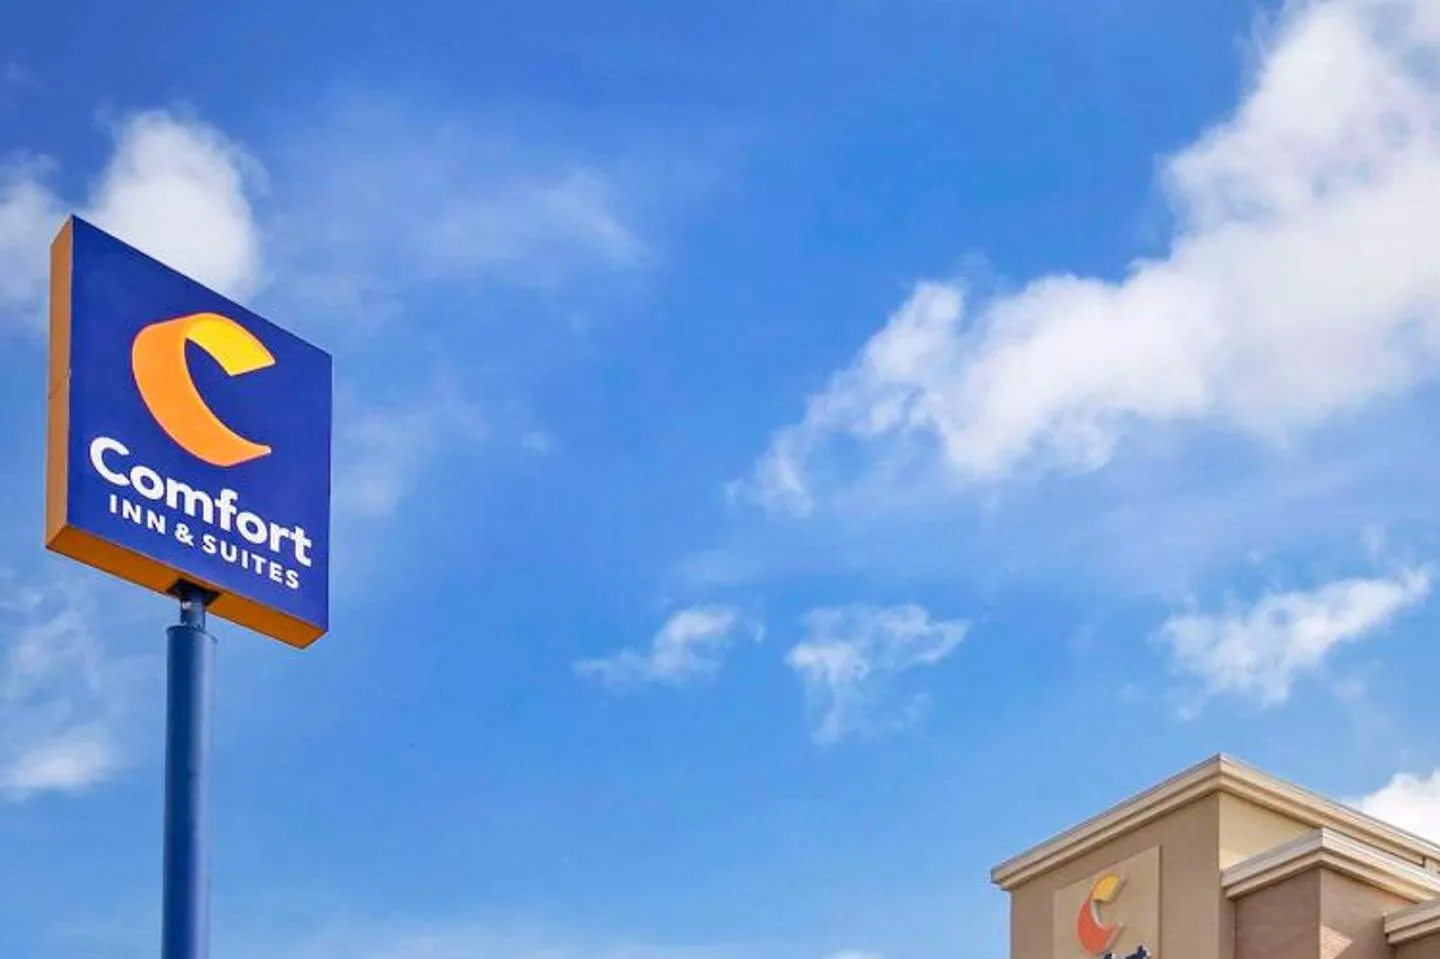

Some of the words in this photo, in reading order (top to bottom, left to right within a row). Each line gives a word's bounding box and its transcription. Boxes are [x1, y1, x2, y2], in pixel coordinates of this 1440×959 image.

[89, 436, 312, 568] Comfort
[109, 494, 167, 536] INN
[175, 522, 195, 548] &
[202, 534, 300, 590] SUITES
